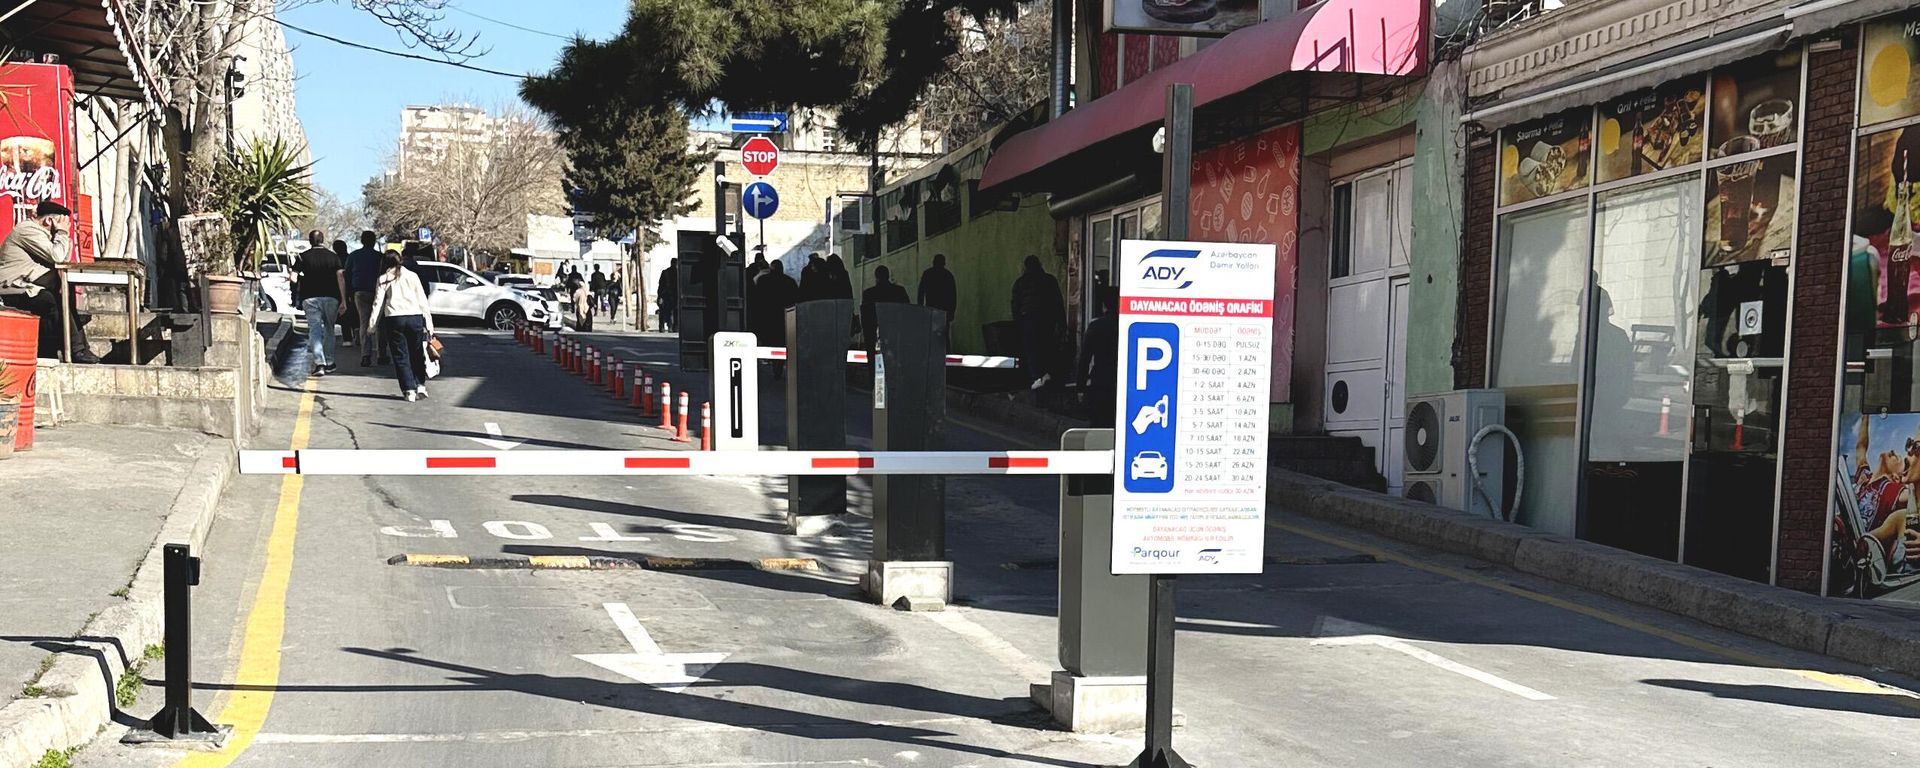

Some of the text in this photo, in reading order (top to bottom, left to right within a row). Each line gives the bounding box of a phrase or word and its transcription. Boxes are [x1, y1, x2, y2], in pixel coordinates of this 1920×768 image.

[743, 151, 776, 163] STOP
[1142, 266, 1186, 280] ADY
[1130, 299, 1263, 316] DAYANACAQ ÖDƏNİŞ QRAFİKİ
[731, 360, 741, 378] P
[1136, 337, 1173, 391] P
[1243, 421, 1256, 429] AZN
[1206, 434, 1222, 442] SAAT
[1243, 434, 1256, 442] AZN
[1205, 461, 1221, 469] SAAT
[1241, 461, 1254, 469] AZN
[380, 519, 738, 542] STOP
[1132, 546, 1180, 560] Parqour
